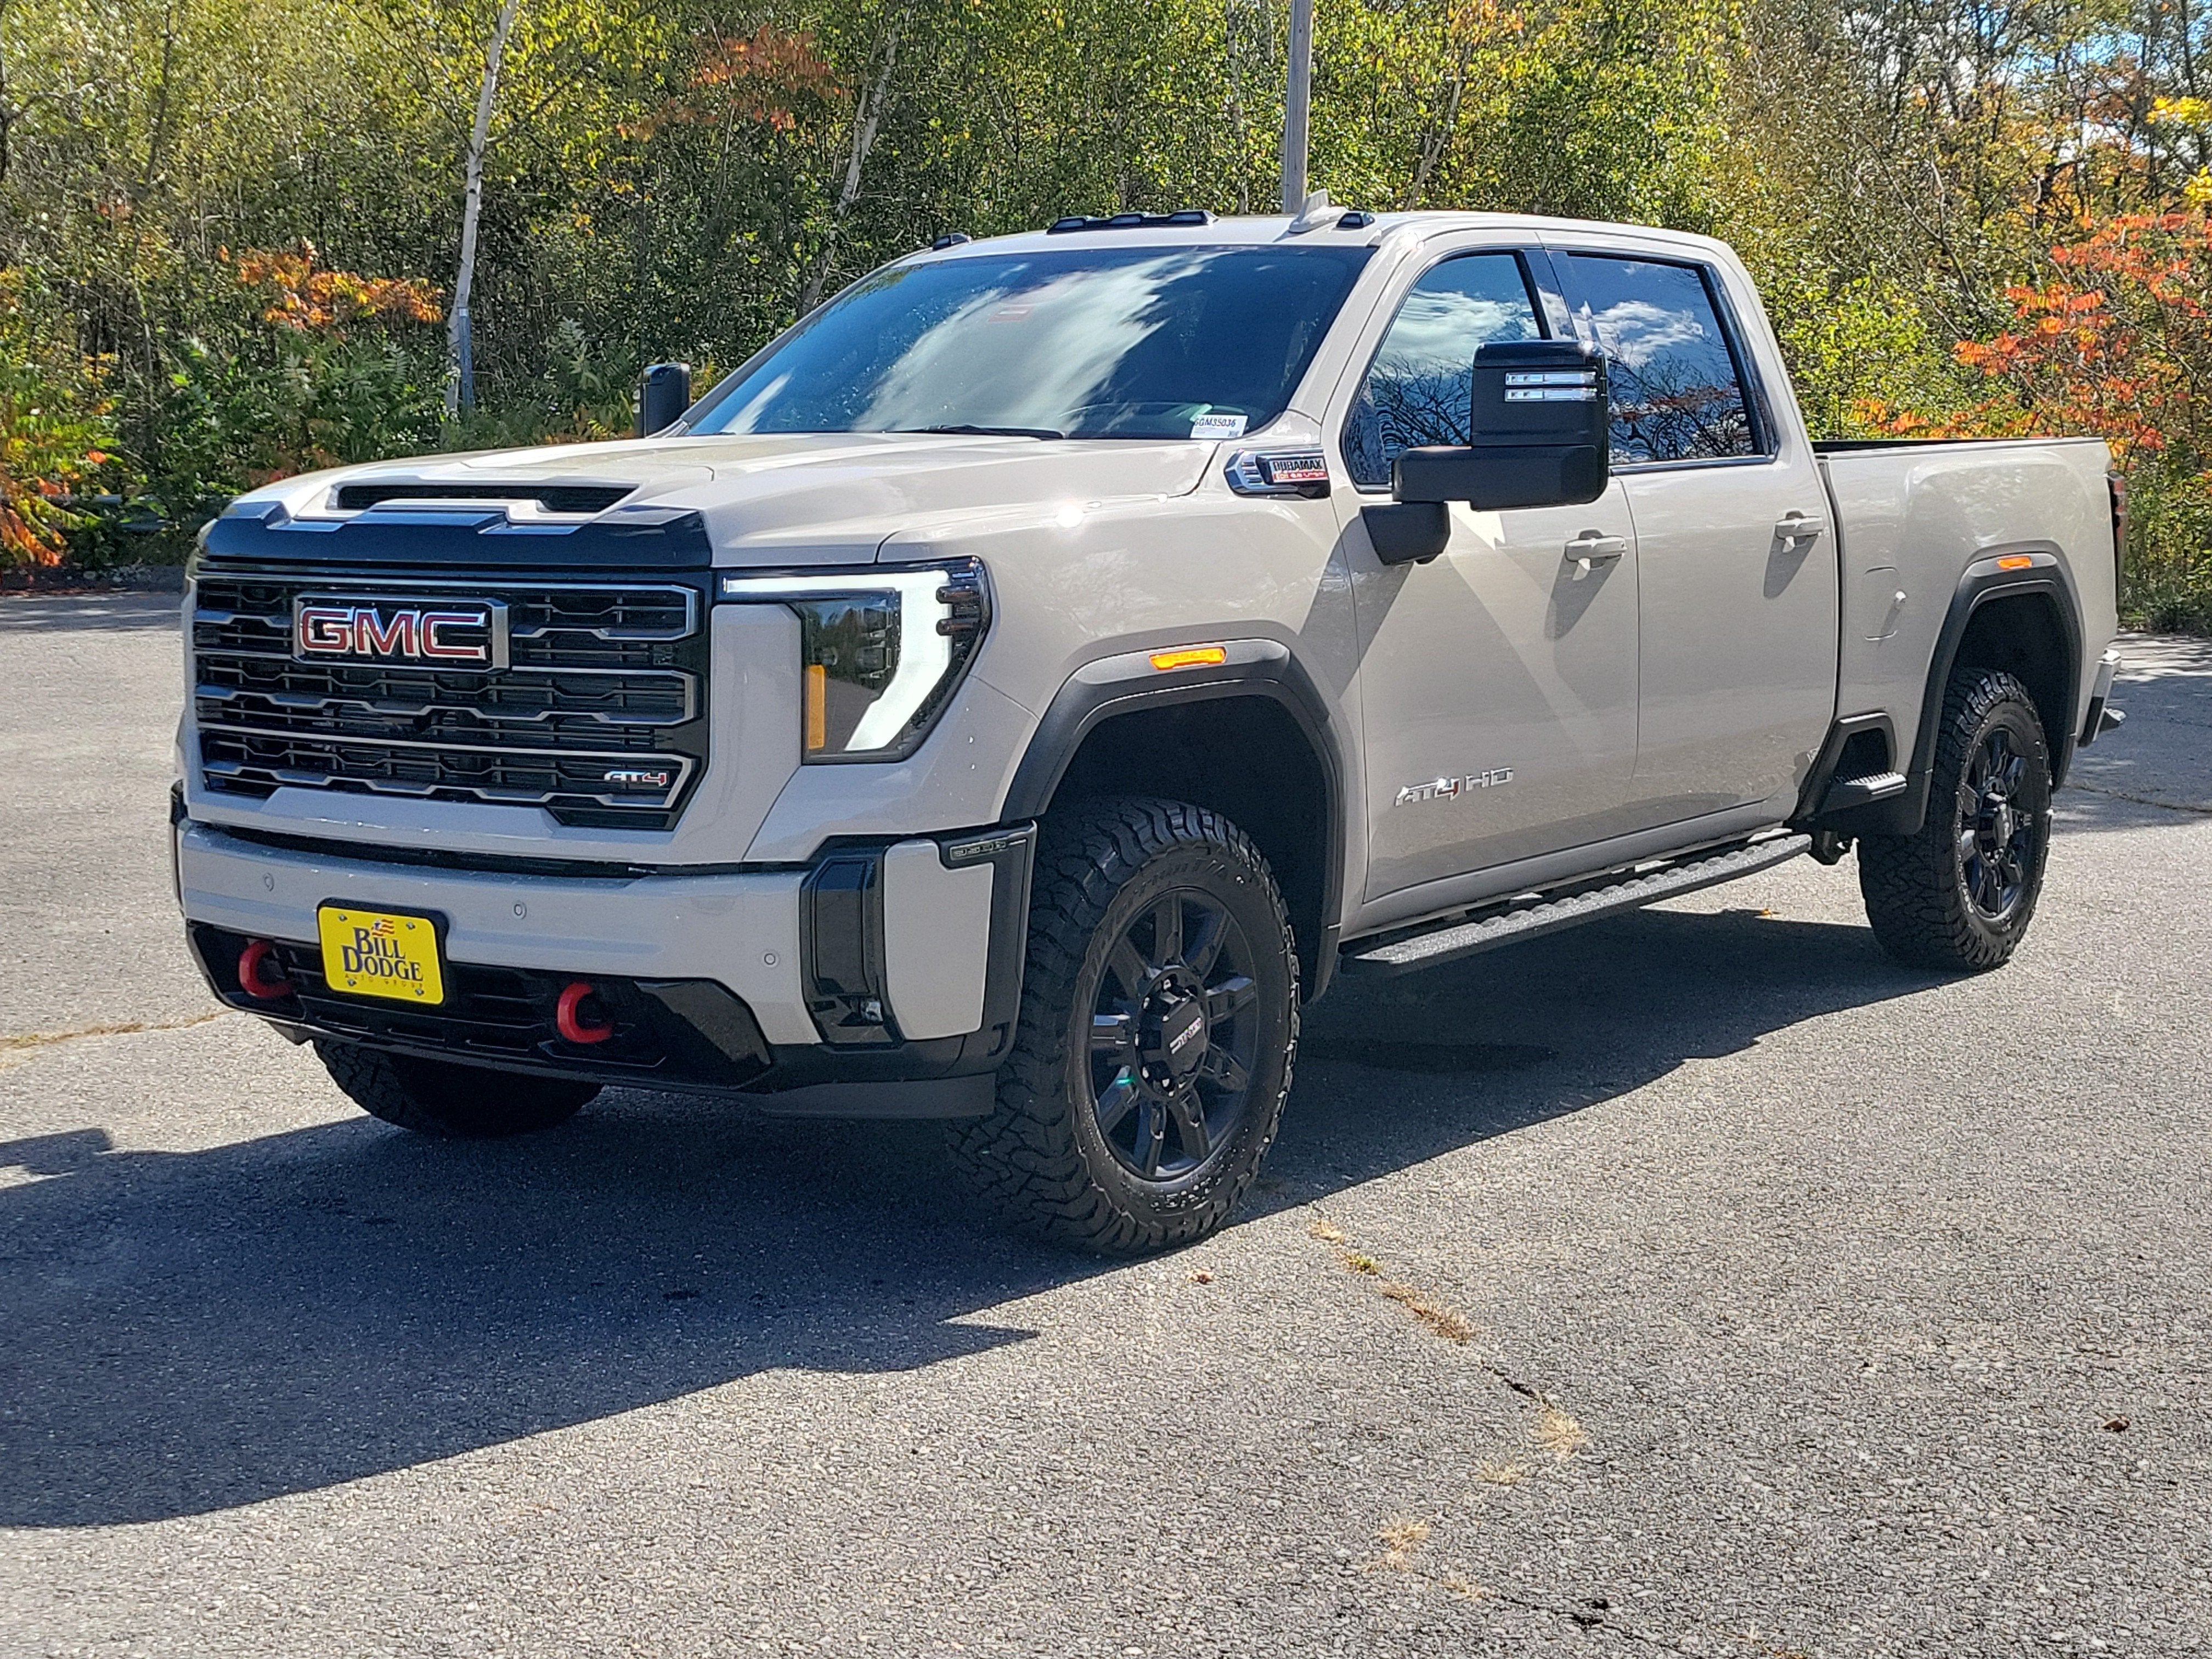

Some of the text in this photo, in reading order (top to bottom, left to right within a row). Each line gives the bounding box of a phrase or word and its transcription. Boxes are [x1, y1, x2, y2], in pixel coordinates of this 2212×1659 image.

[1272, 459, 1322, 472] DURAMAX
[300, 606, 487, 658] GMC
[603, 770, 667, 787] AT4
[1395, 767, 1514, 806] AT4 HD
[353, 927, 405, 960] BILL
[342, 945, 424, 981] DODGE
